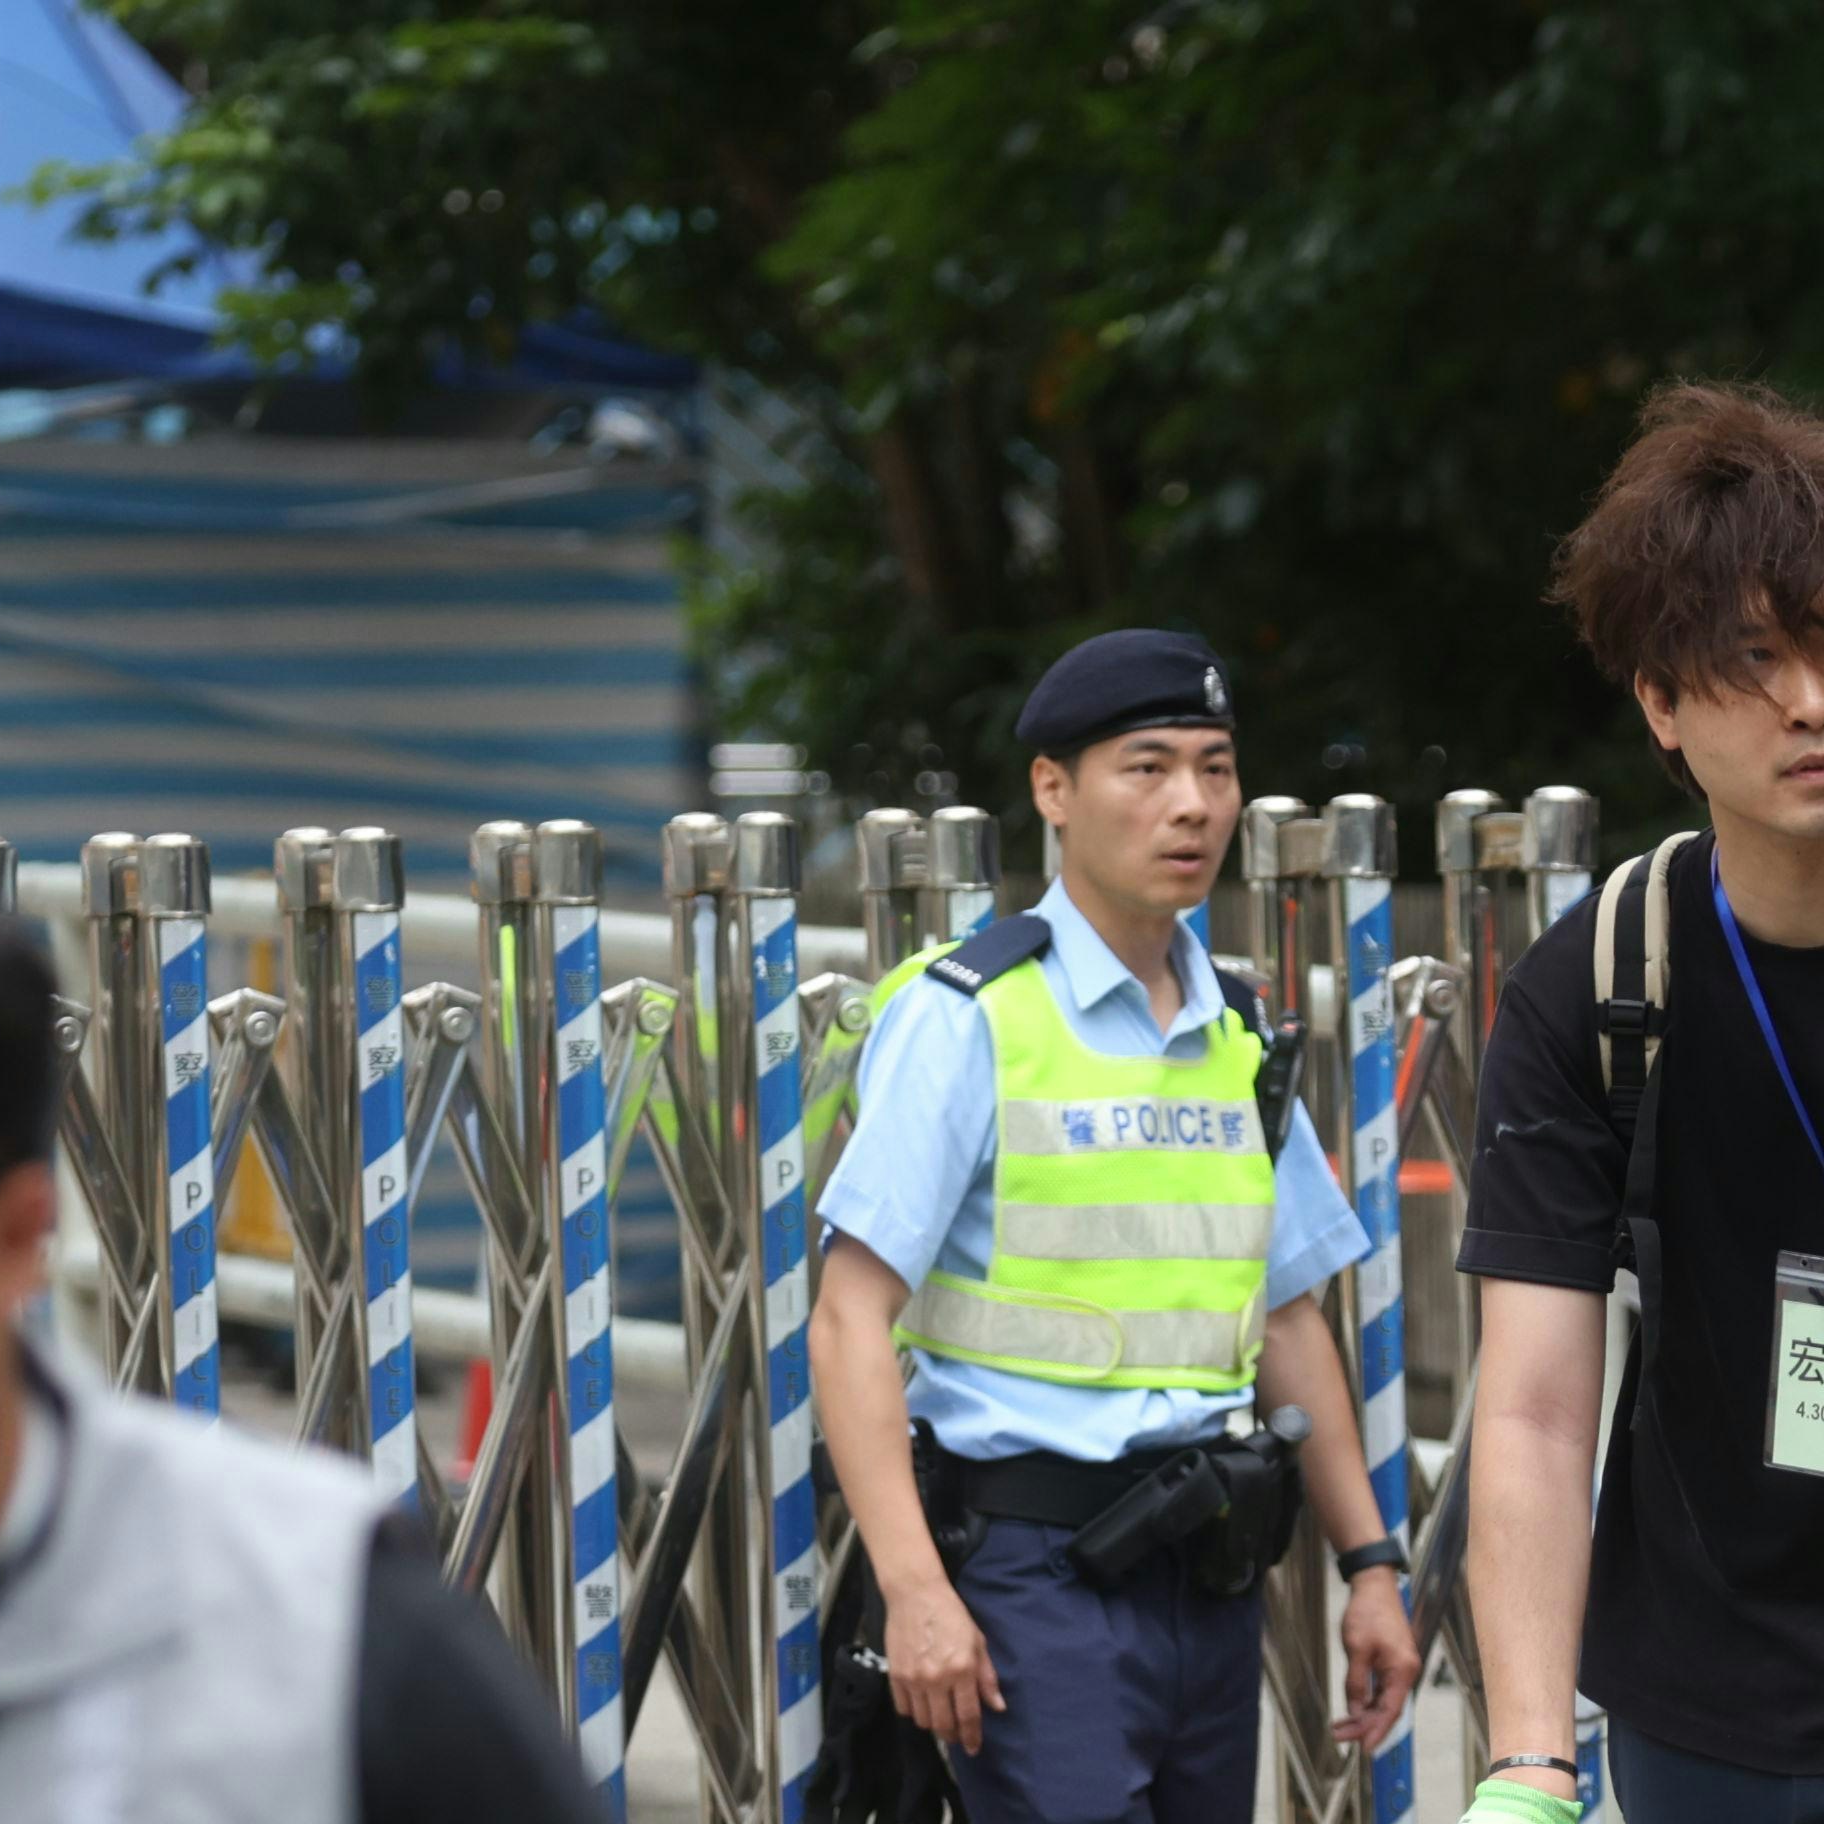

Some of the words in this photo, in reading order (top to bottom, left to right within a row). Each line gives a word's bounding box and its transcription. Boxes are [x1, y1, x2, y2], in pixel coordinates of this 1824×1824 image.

[172, 982, 204, 1085] 警察
[366, 976, 396, 1079] 警察
[565, 968, 596, 1072] 警察
[1111, 1104, 1214, 1144] POLICE
[378, 1175, 401, 1417] POLICE
[576, 1167, 600, 1409] POLICE
[777, 1159, 800, 1409] POLICE
[585, 1584, 616, 1686] 警察
[784, 1574, 813, 1676] 警察
